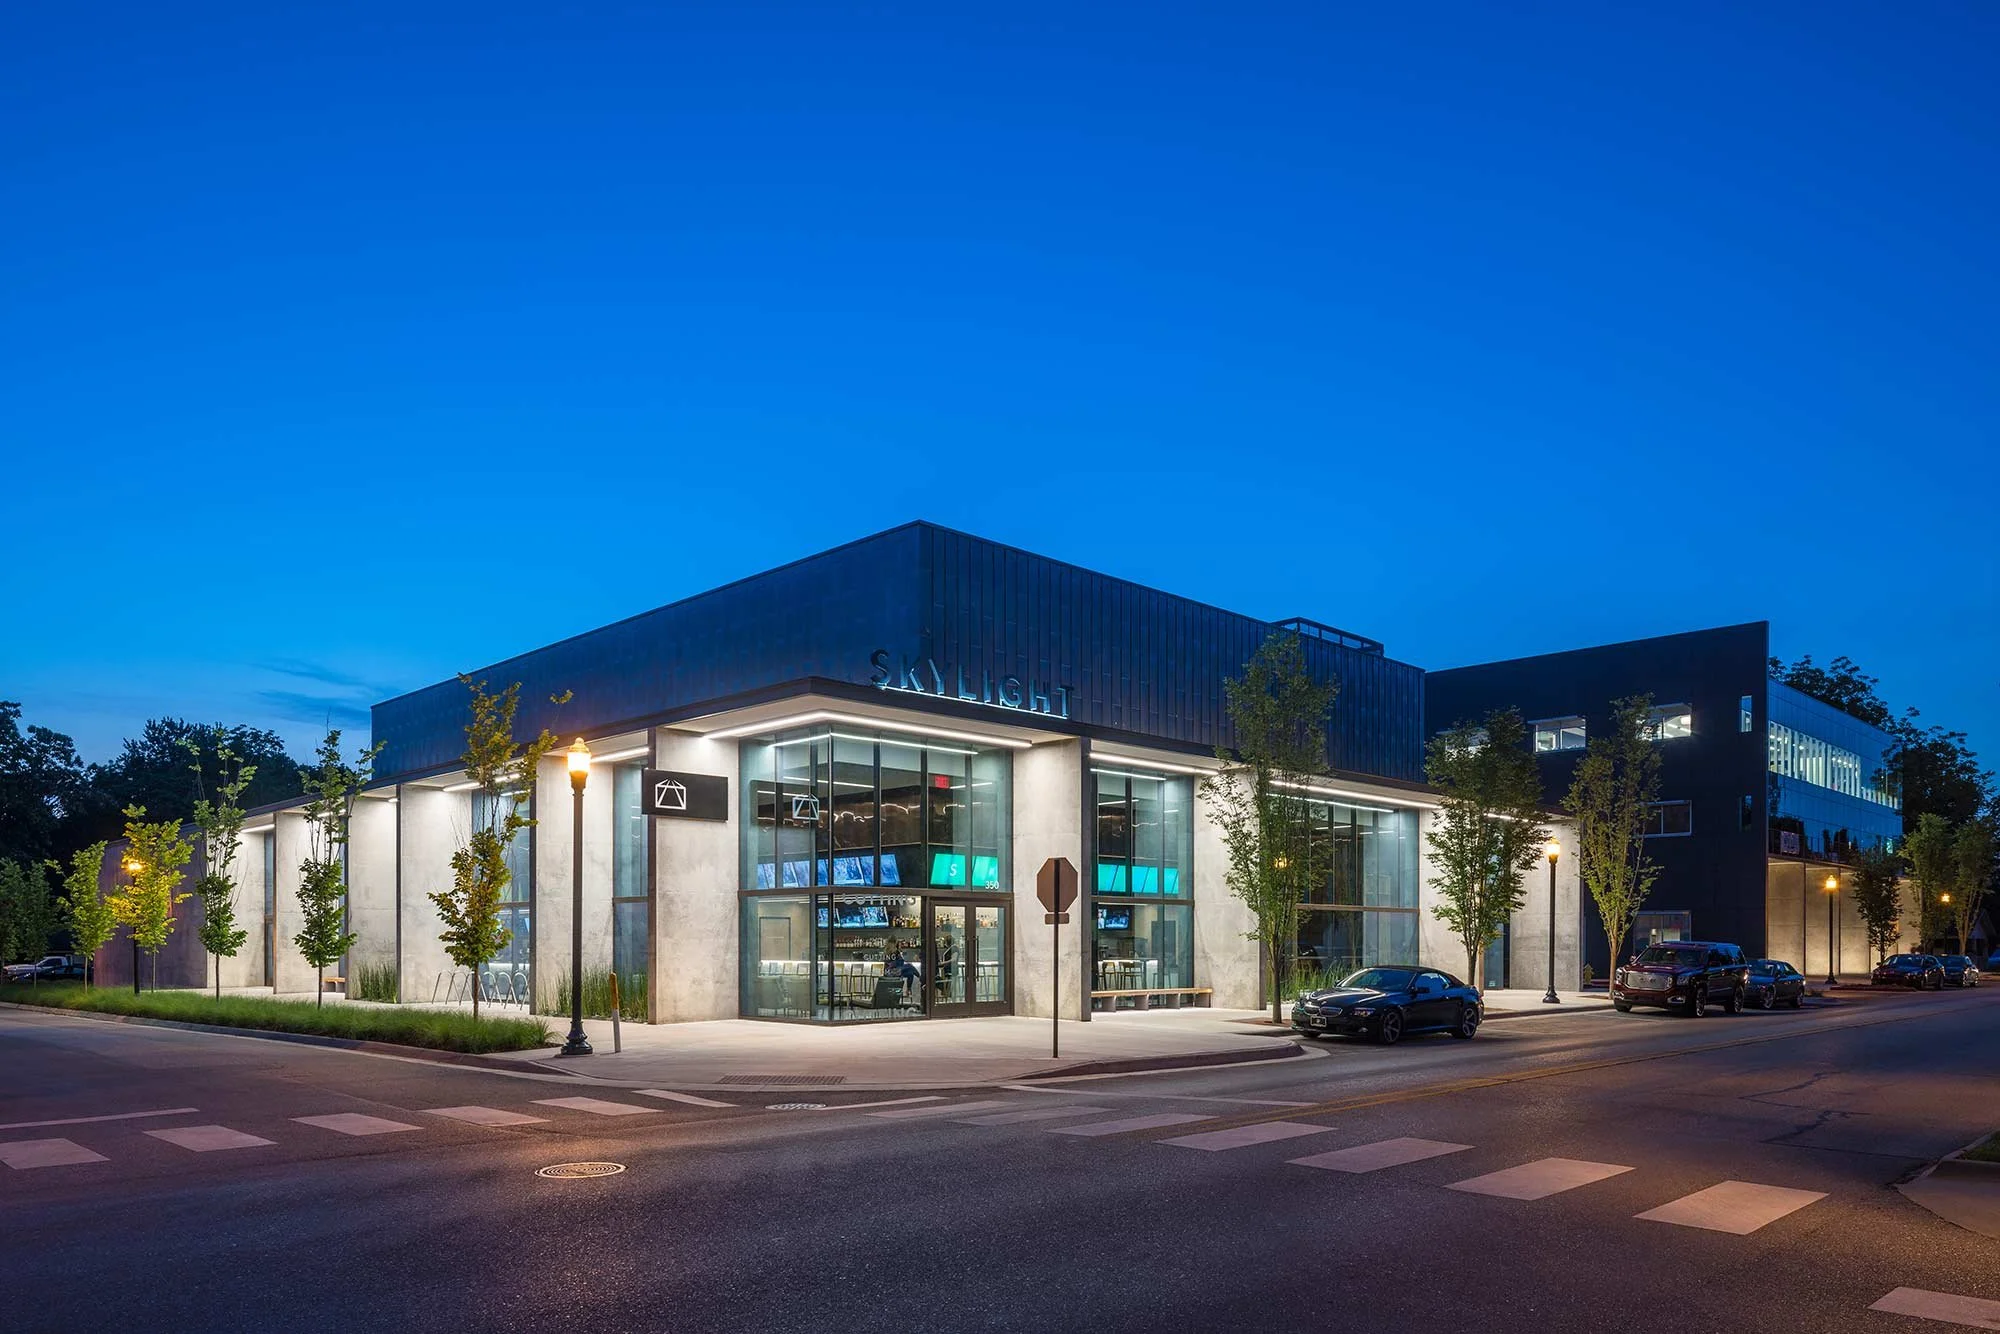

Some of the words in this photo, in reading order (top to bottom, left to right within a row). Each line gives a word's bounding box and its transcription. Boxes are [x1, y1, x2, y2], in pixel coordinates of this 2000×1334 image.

[870, 649, 1075, 716] SKYLIGHT
[949, 864, 957, 876] S
[985, 880, 1000, 890] 350
